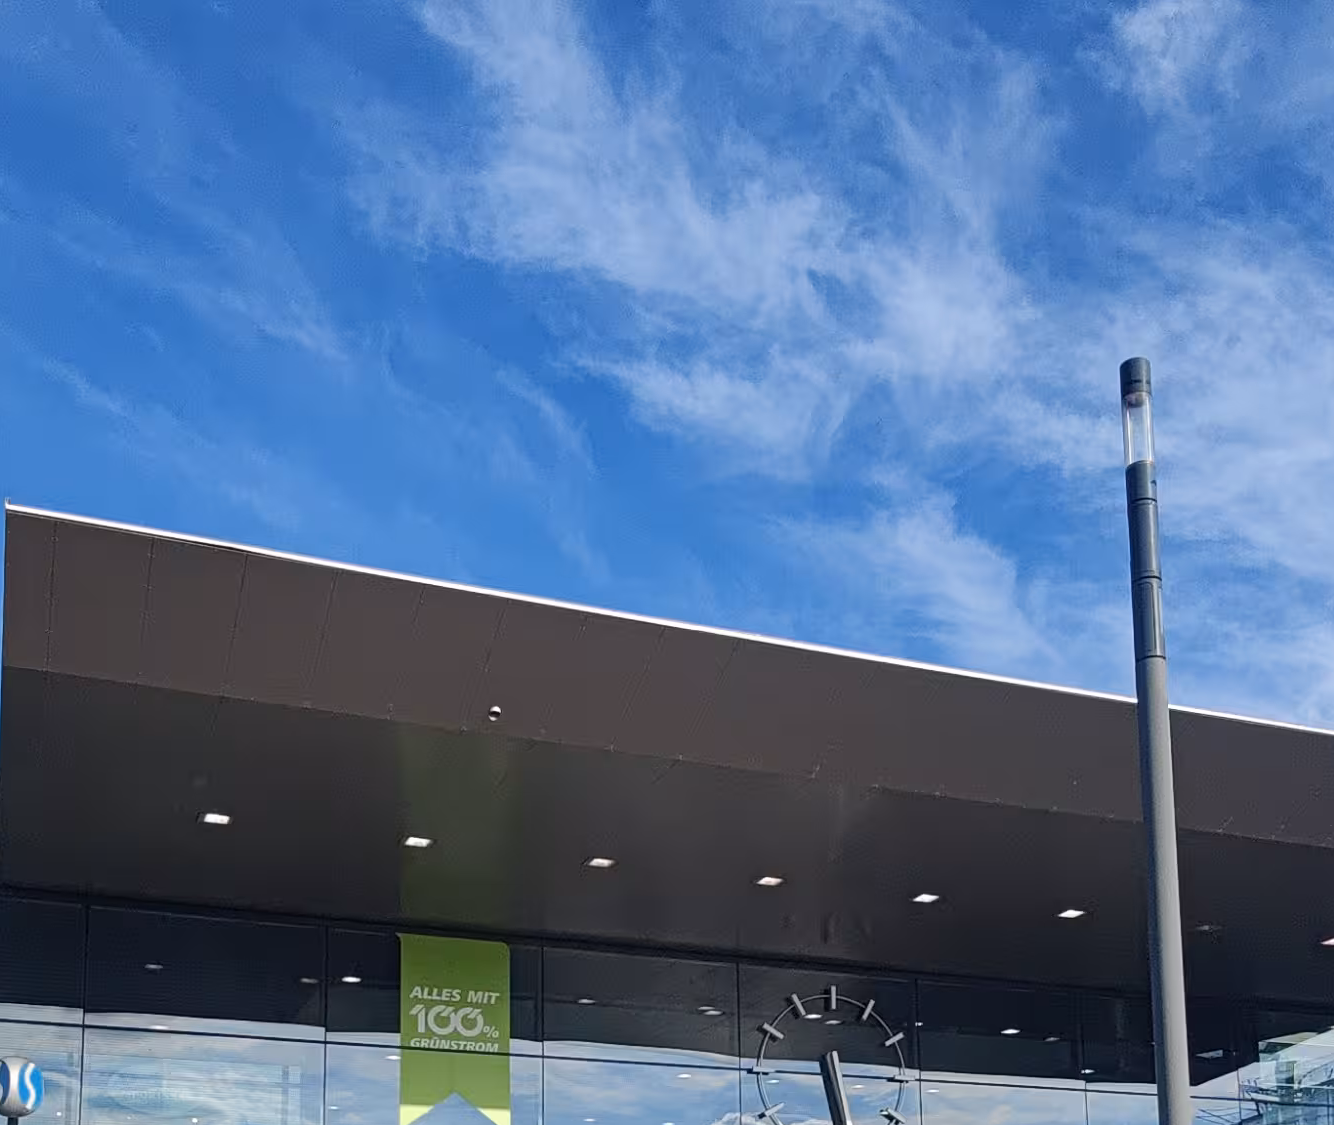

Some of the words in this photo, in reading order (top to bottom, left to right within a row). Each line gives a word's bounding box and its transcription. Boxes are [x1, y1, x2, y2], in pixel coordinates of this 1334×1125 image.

[409, 985, 461, 1002] ALLES
[467, 990, 500, 1005] MIT
[409, 1004, 499, 1038] 100%
[410, 1036, 499, 1053] GRÜNSTROM
